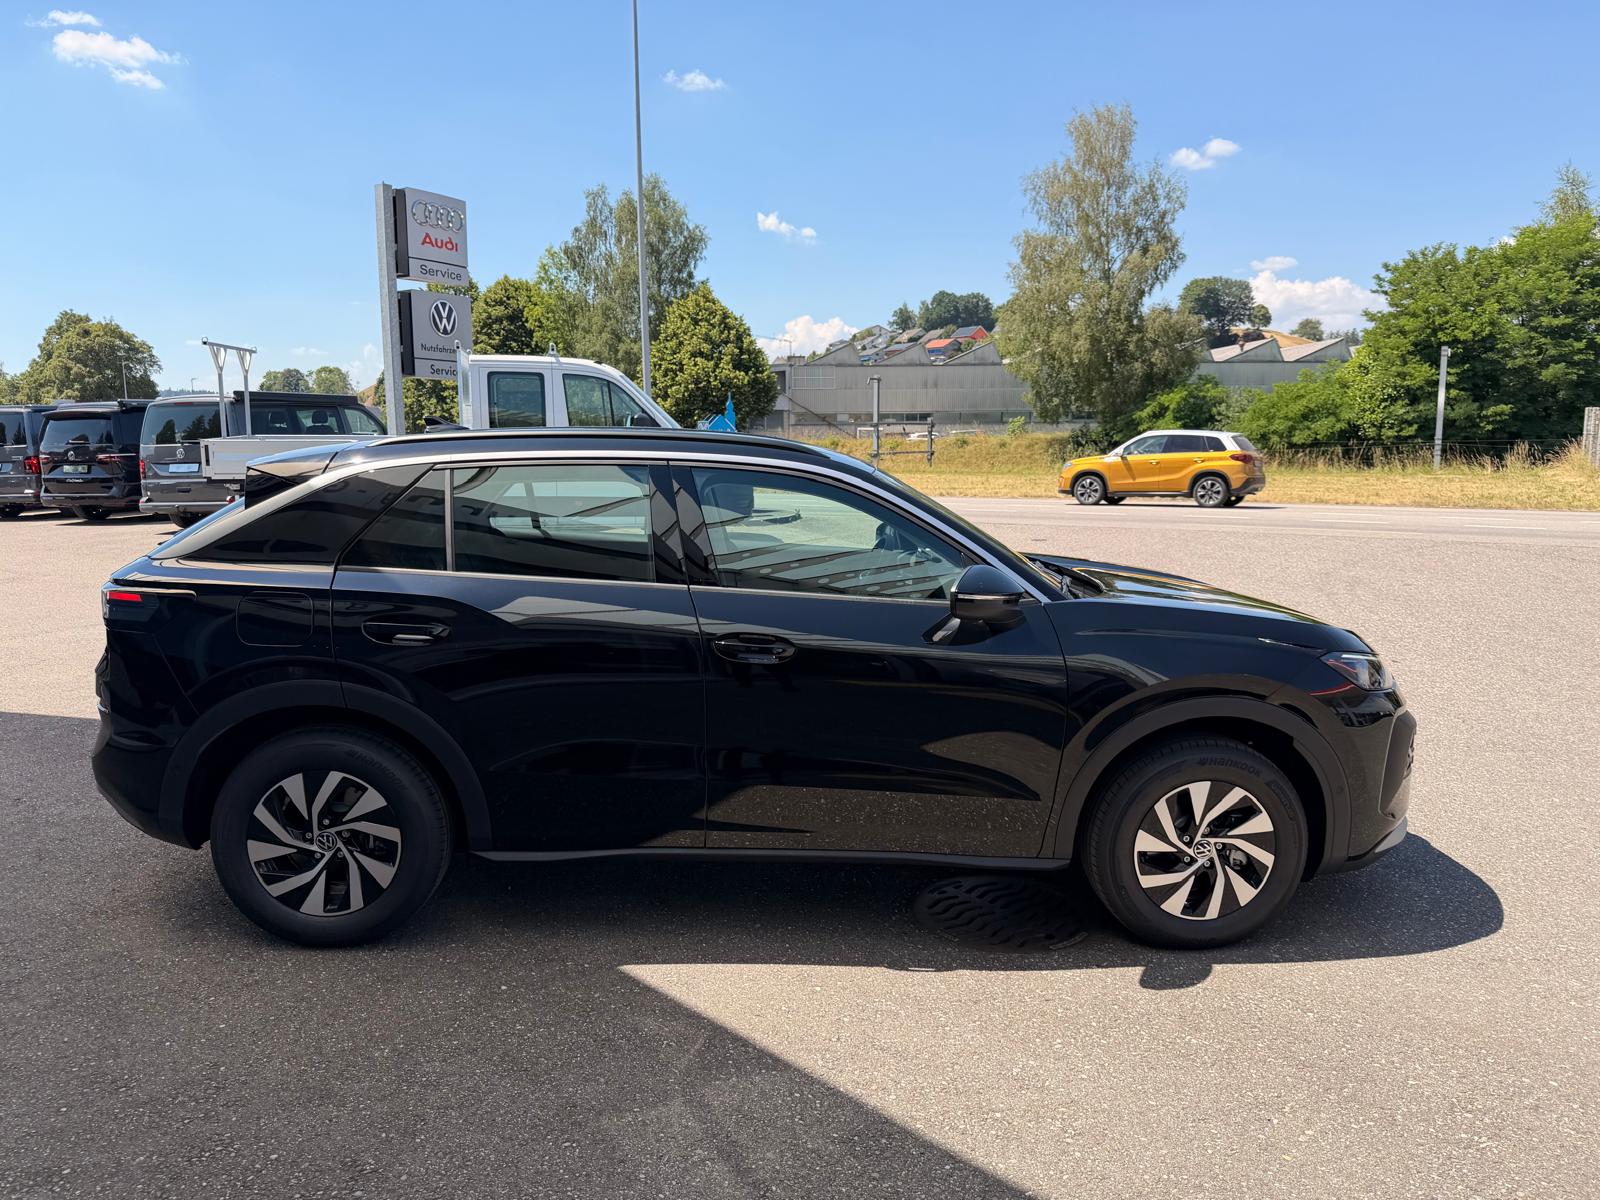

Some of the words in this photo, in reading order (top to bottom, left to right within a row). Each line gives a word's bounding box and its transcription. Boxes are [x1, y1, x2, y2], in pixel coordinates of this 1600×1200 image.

[421, 232, 458, 252] Audi
[420, 264, 462, 281] Service
[432, 301, 457, 336] VW
[420, 343, 456, 354] Nutzfahrze
[430, 364, 457, 376] Servic
